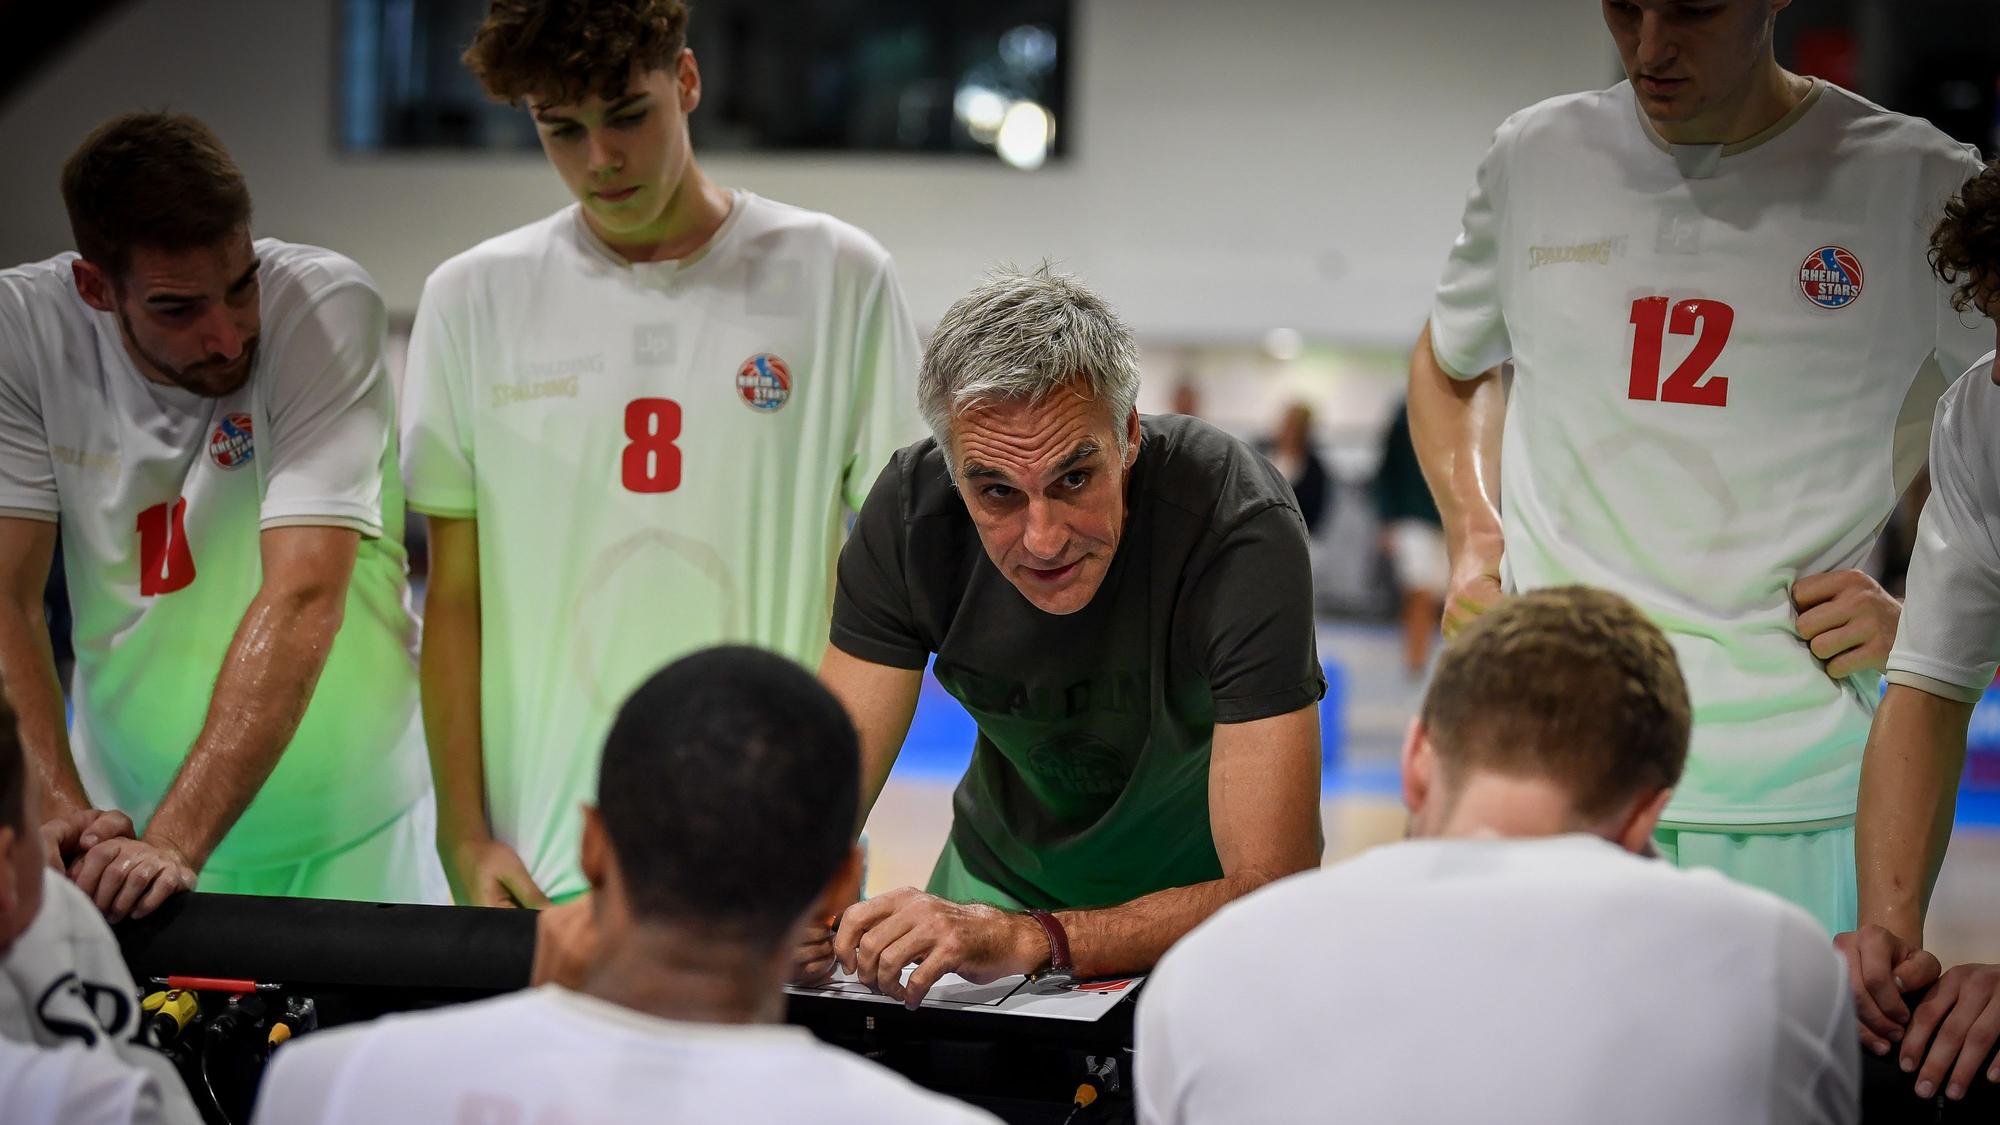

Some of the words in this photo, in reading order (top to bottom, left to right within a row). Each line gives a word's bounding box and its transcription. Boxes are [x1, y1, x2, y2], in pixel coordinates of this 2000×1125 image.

[1801, 269, 1840, 283] RHEIN
[1818, 282, 1859, 297] STARS
[1628, 296, 1735, 407] 12
[621, 396, 683, 493] 8
